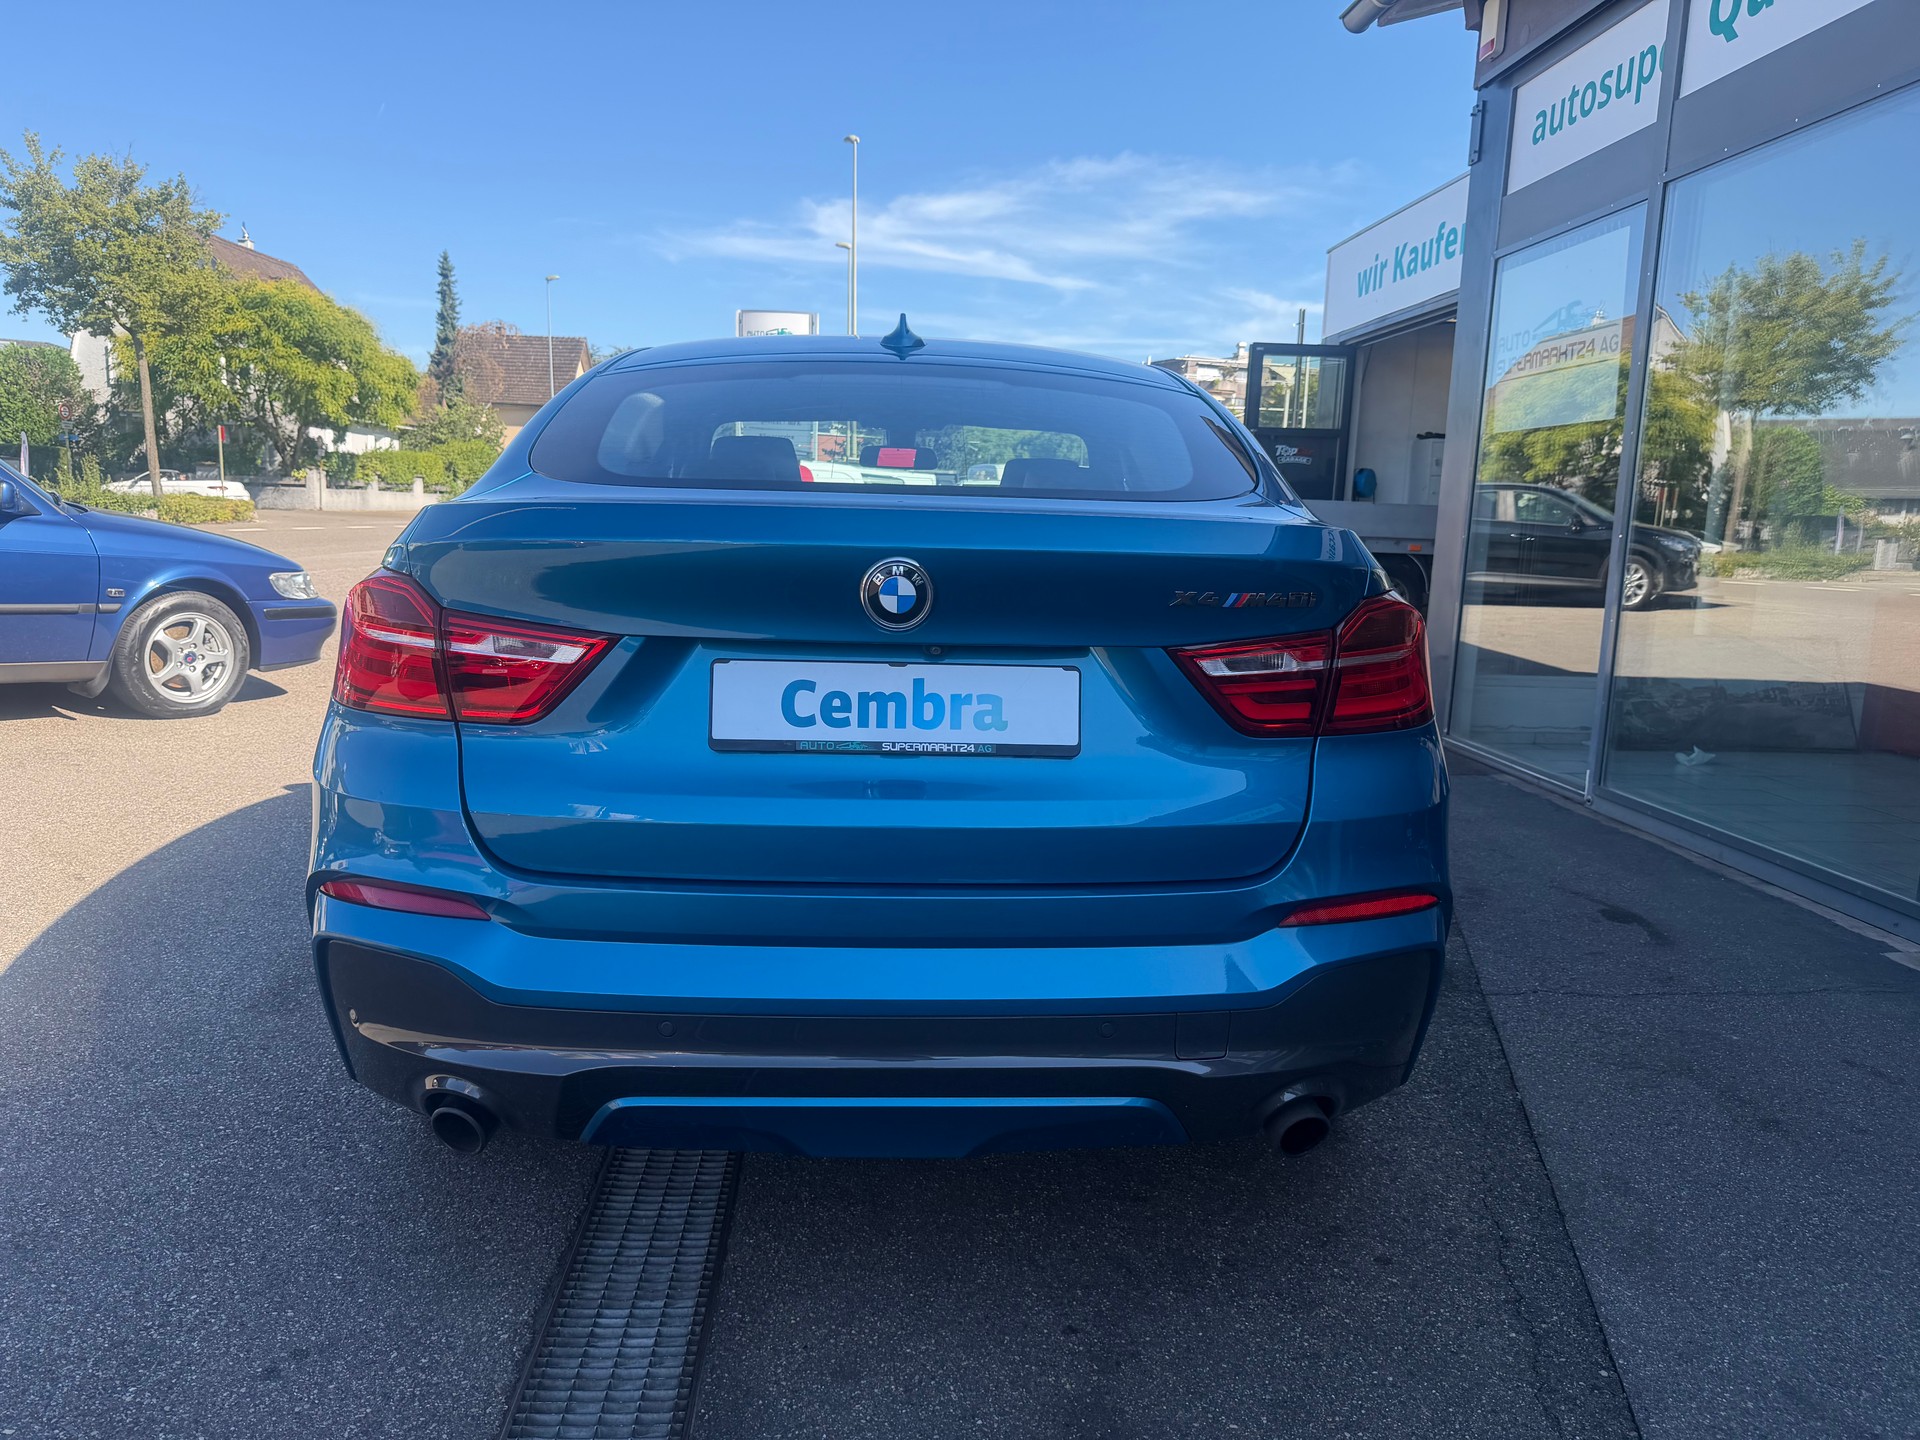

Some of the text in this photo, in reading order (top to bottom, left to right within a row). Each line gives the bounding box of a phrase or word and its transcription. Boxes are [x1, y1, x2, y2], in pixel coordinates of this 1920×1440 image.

[1357, 253, 1388, 298] wir
[1498, 330, 1531, 353] AUTO
[1600, 333, 1619, 354] AG
[872, 565, 924, 587] BMW
[1169, 590, 1219, 607] X4
[780, 678, 1009, 732] Cembra
[799, 741, 992, 753] AUTO SUPERMARKT24 AG
